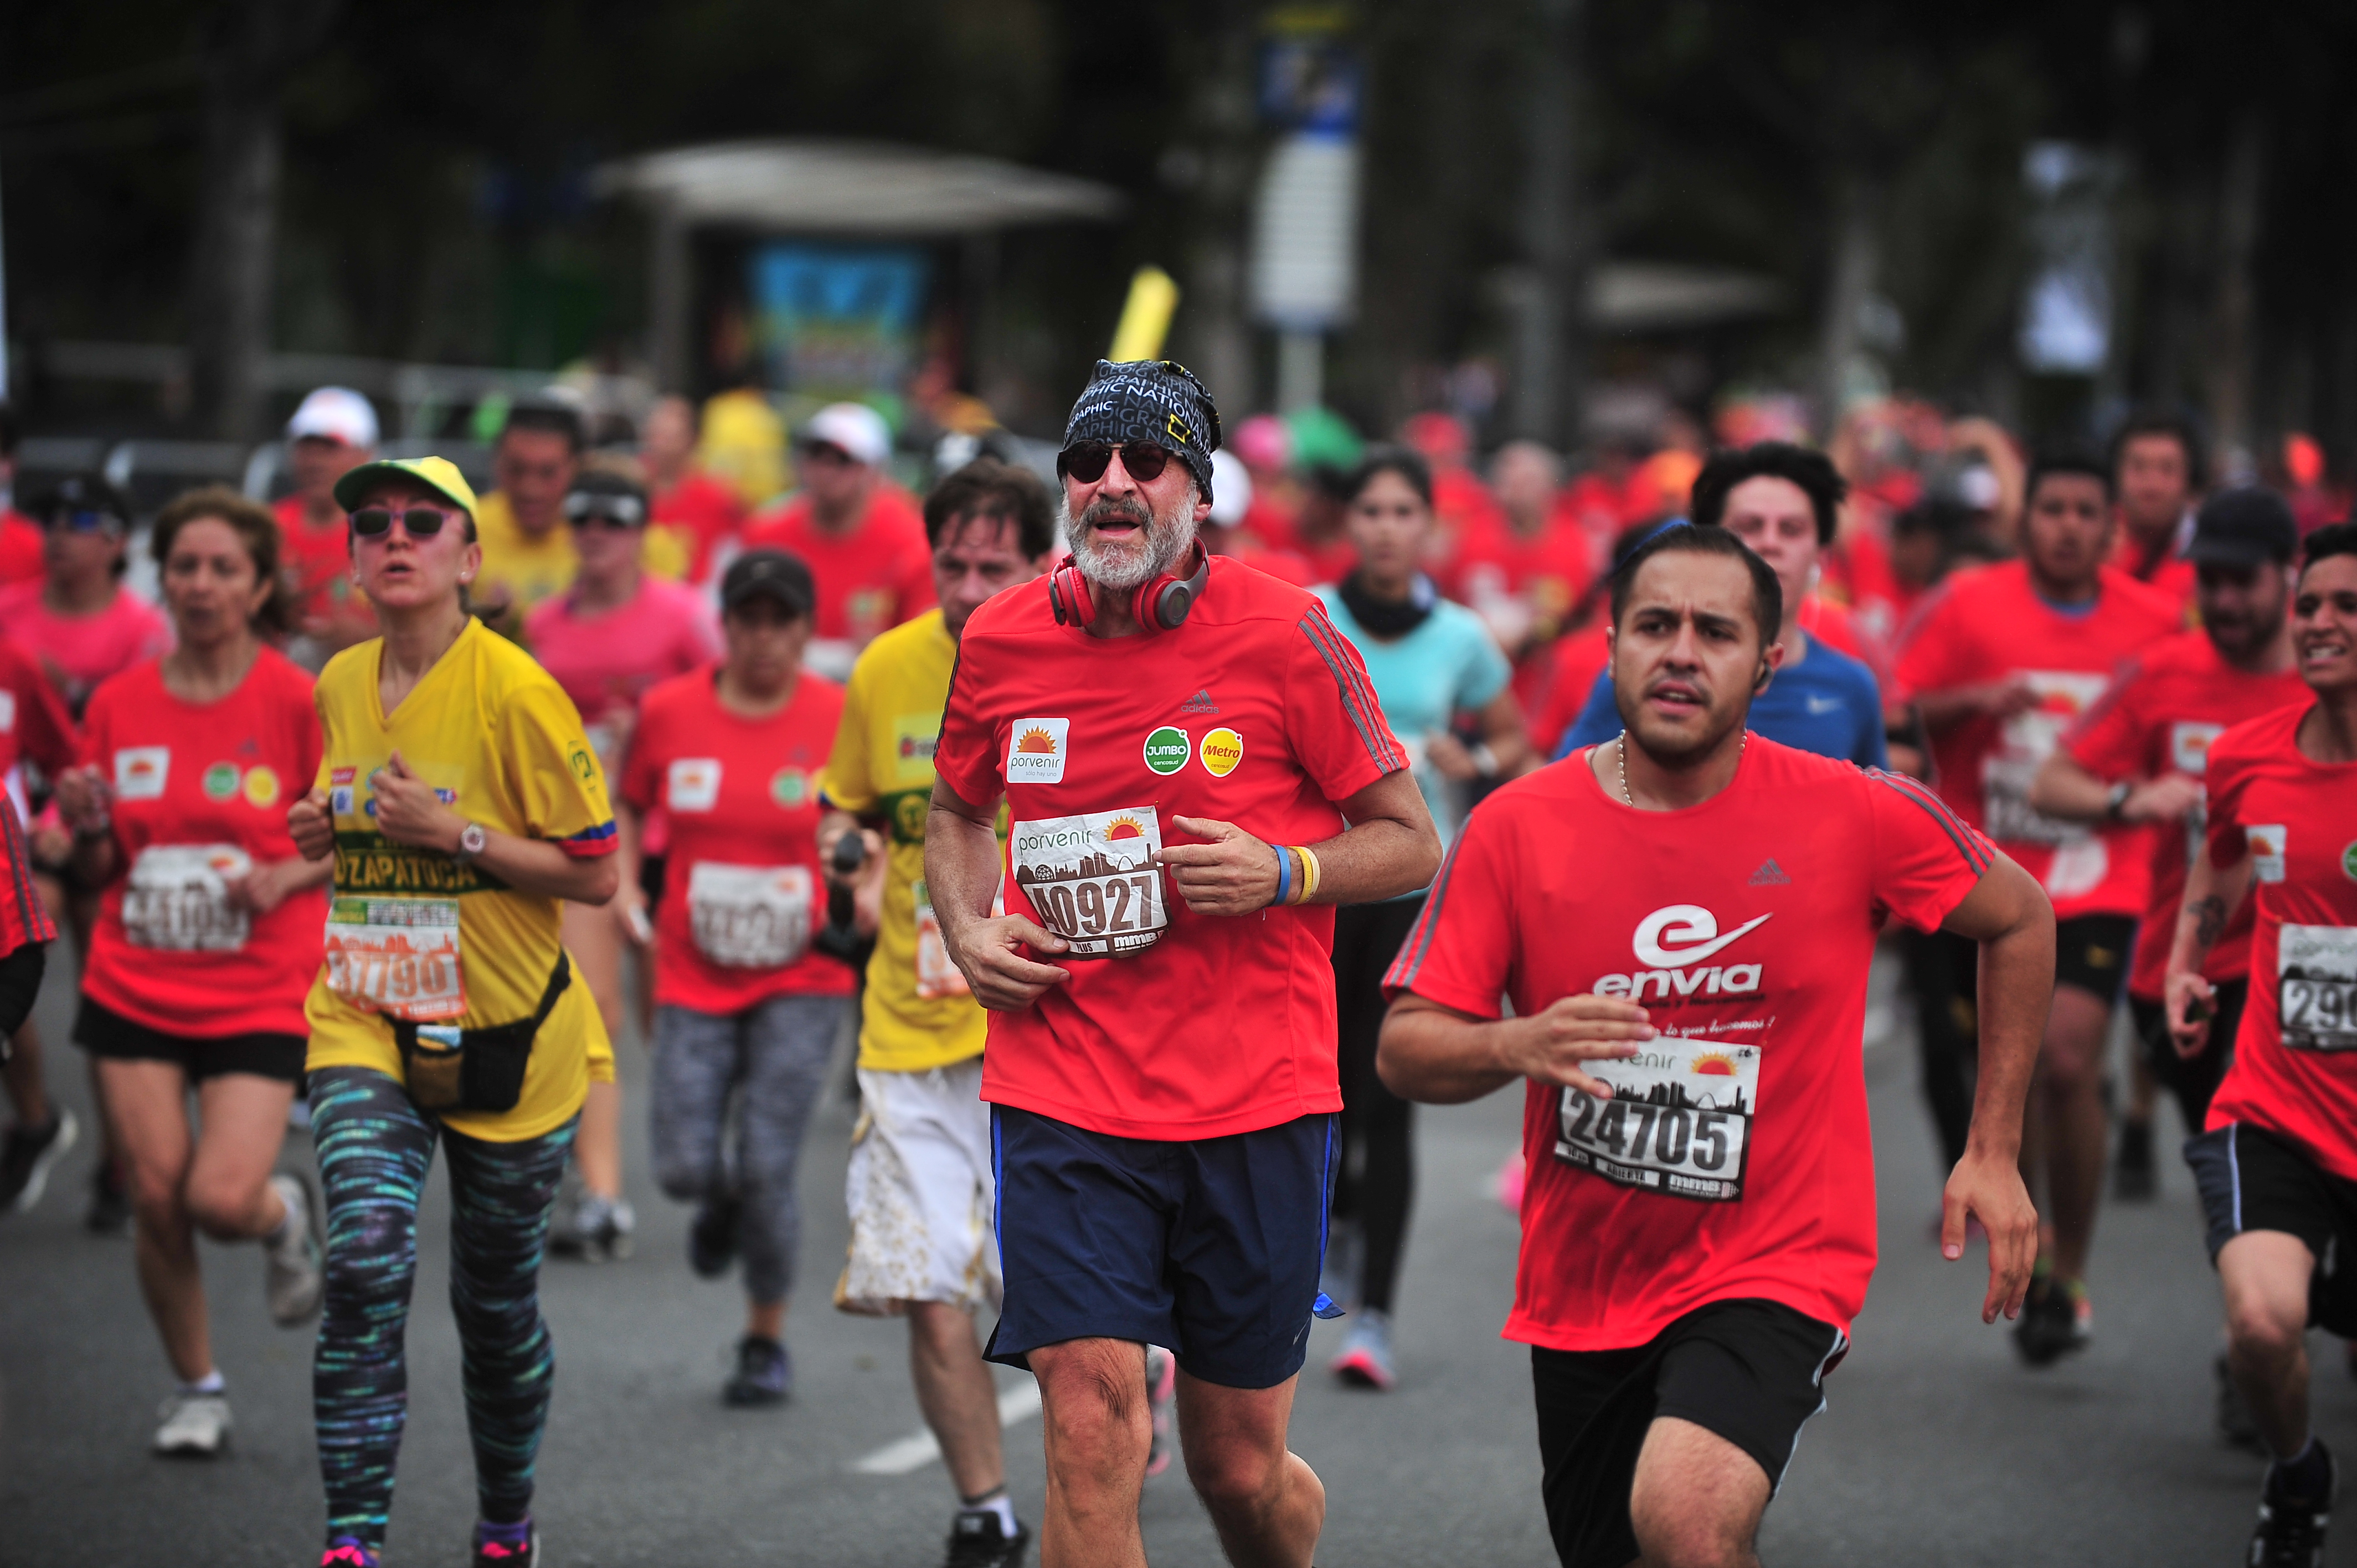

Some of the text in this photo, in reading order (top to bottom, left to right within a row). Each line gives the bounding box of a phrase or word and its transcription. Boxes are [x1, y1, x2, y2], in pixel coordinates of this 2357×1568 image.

[1181, 704, 1219, 714] adidas
[1147, 745, 1186, 756] JUMBO
[1203, 745, 1240, 758] Metro
[1011, 757, 1060, 770] porvenir
[1018, 830, 1092, 855] porvenir
[1032, 875, 1152, 936] 40927
[1570, 1090, 1728, 1171] 24705
